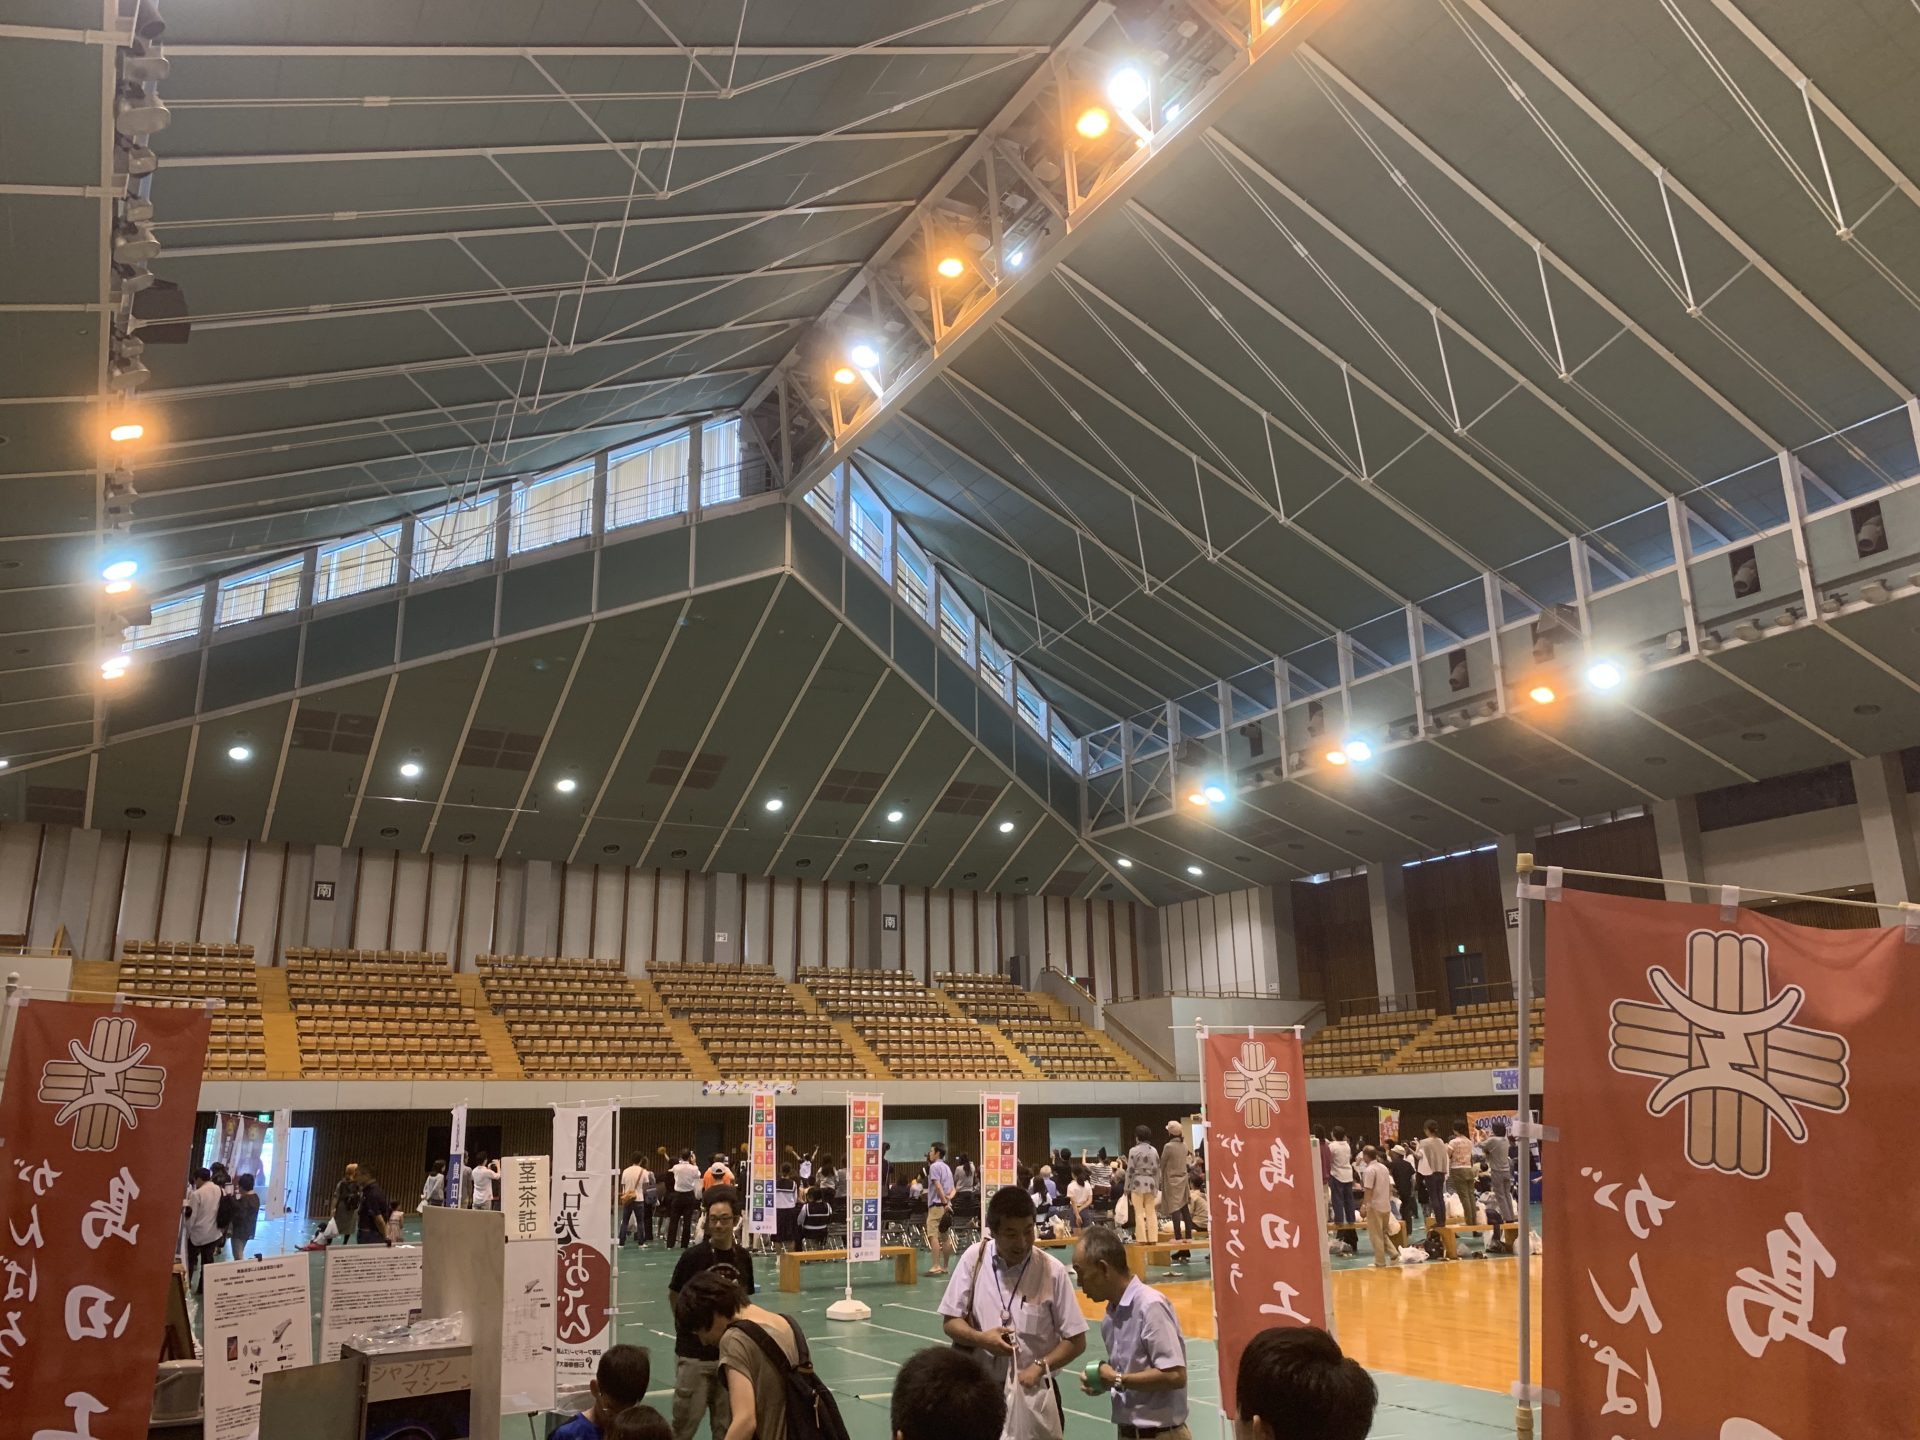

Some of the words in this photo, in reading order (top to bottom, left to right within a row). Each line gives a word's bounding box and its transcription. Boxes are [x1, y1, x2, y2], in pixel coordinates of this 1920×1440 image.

[316, 884, 333, 898] 南
[884, 916, 896, 929] 南
[518, 1161, 538, 1239] 茎茶詰
